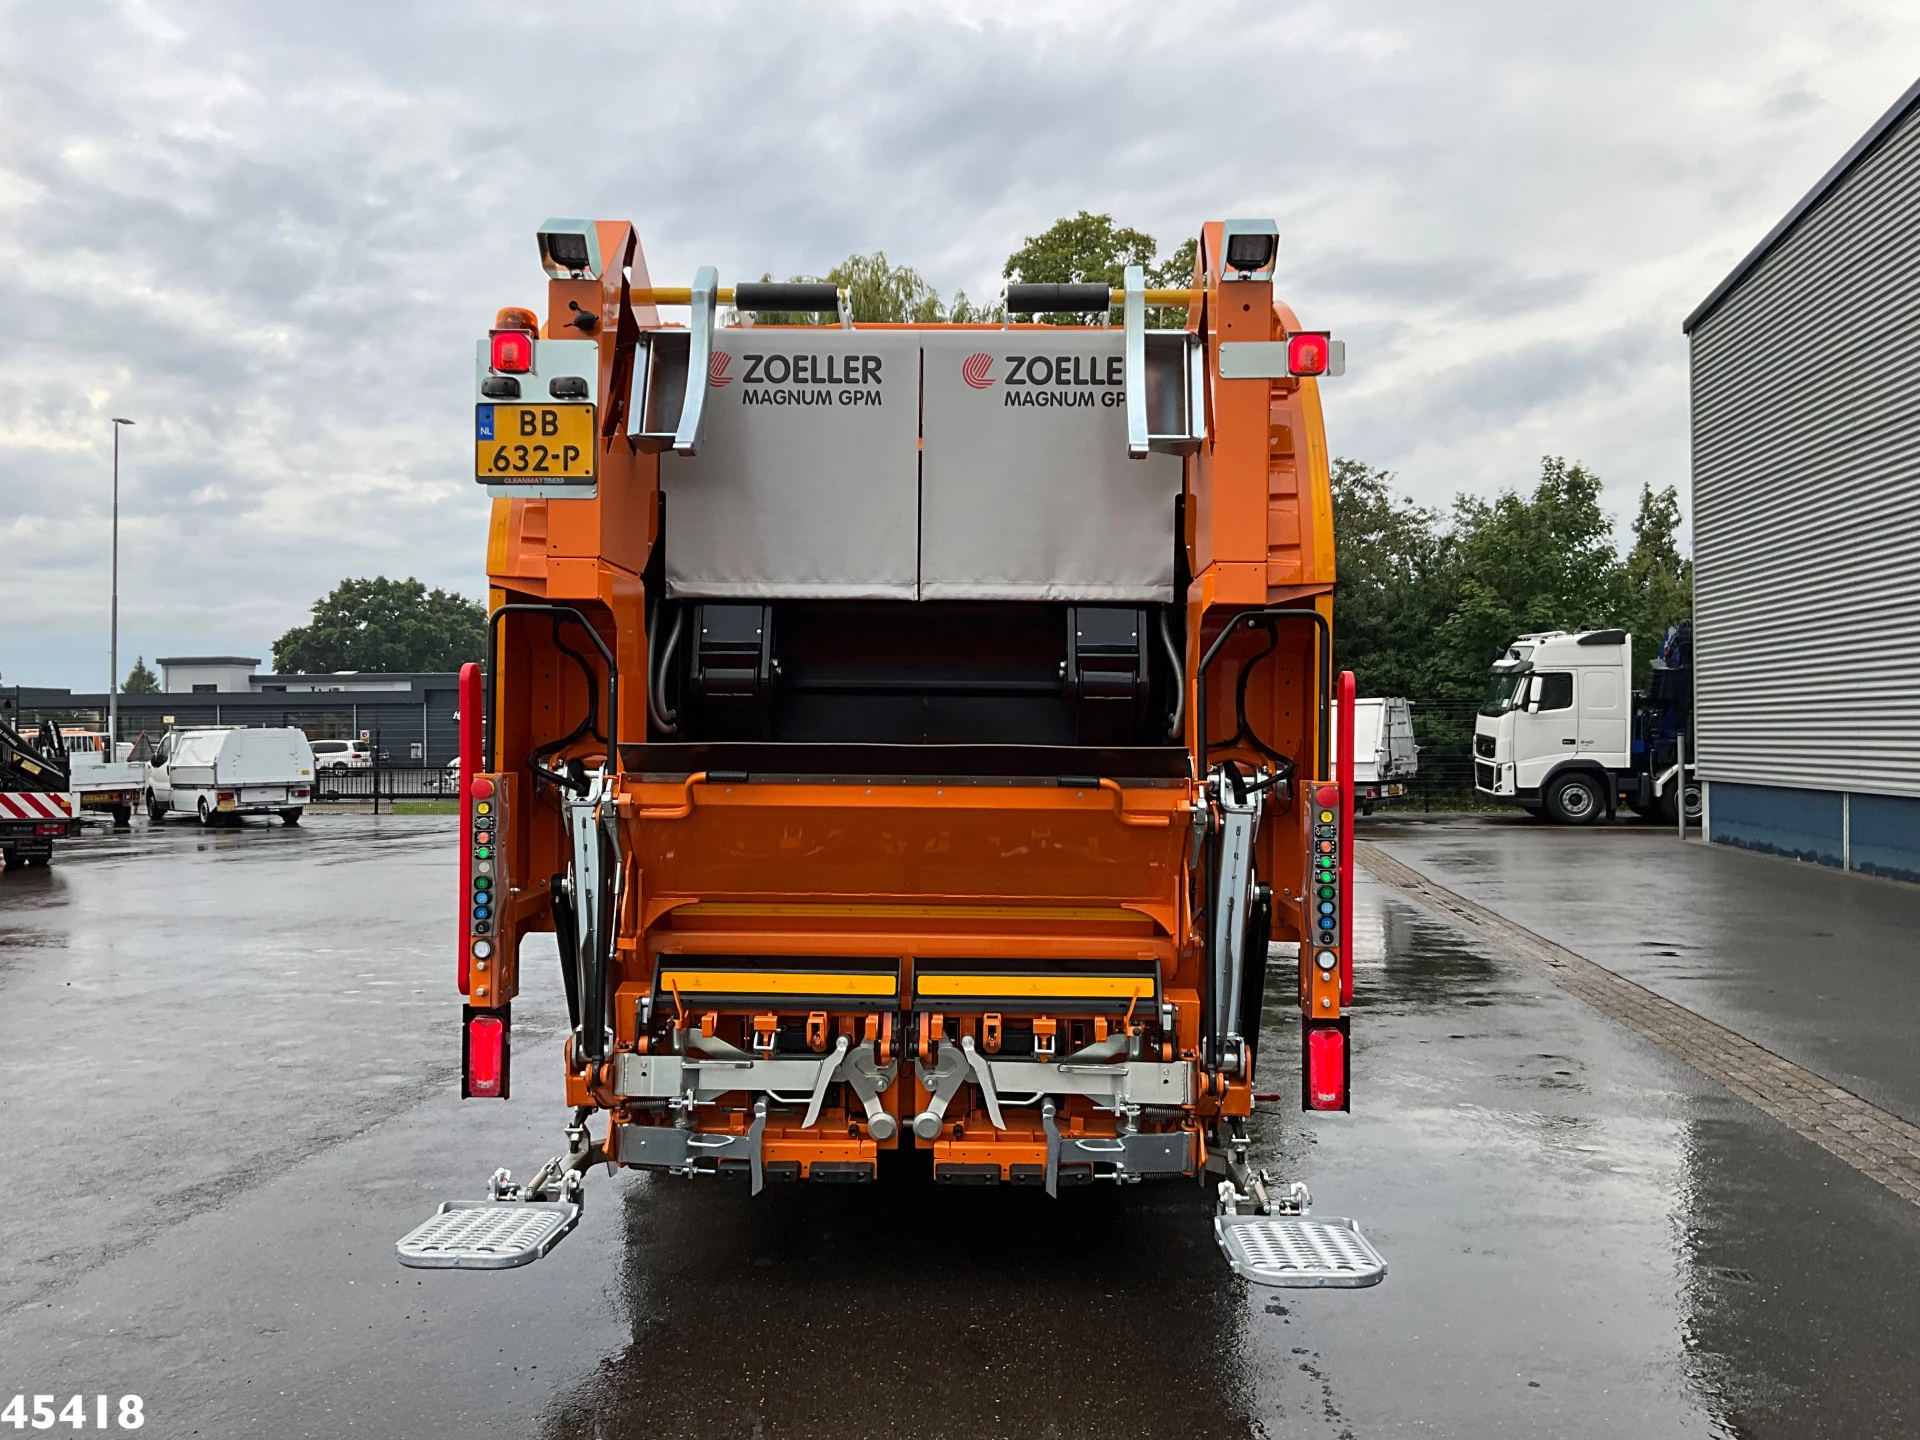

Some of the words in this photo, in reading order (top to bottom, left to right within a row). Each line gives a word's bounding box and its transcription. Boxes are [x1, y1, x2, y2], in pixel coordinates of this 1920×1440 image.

[742, 354, 882, 385] ZOELLER
[1004, 355, 1123, 386] ZOELLE
[742, 389, 833, 406] MAGNUM
[838, 389, 882, 406] GPM
[1004, 390, 1095, 407] MAGNUM
[1101, 391, 1126, 408] GP
[480, 427, 493, 436] NL
[520, 409, 559, 437] BB
[493, 444, 580, 472] 632-P
